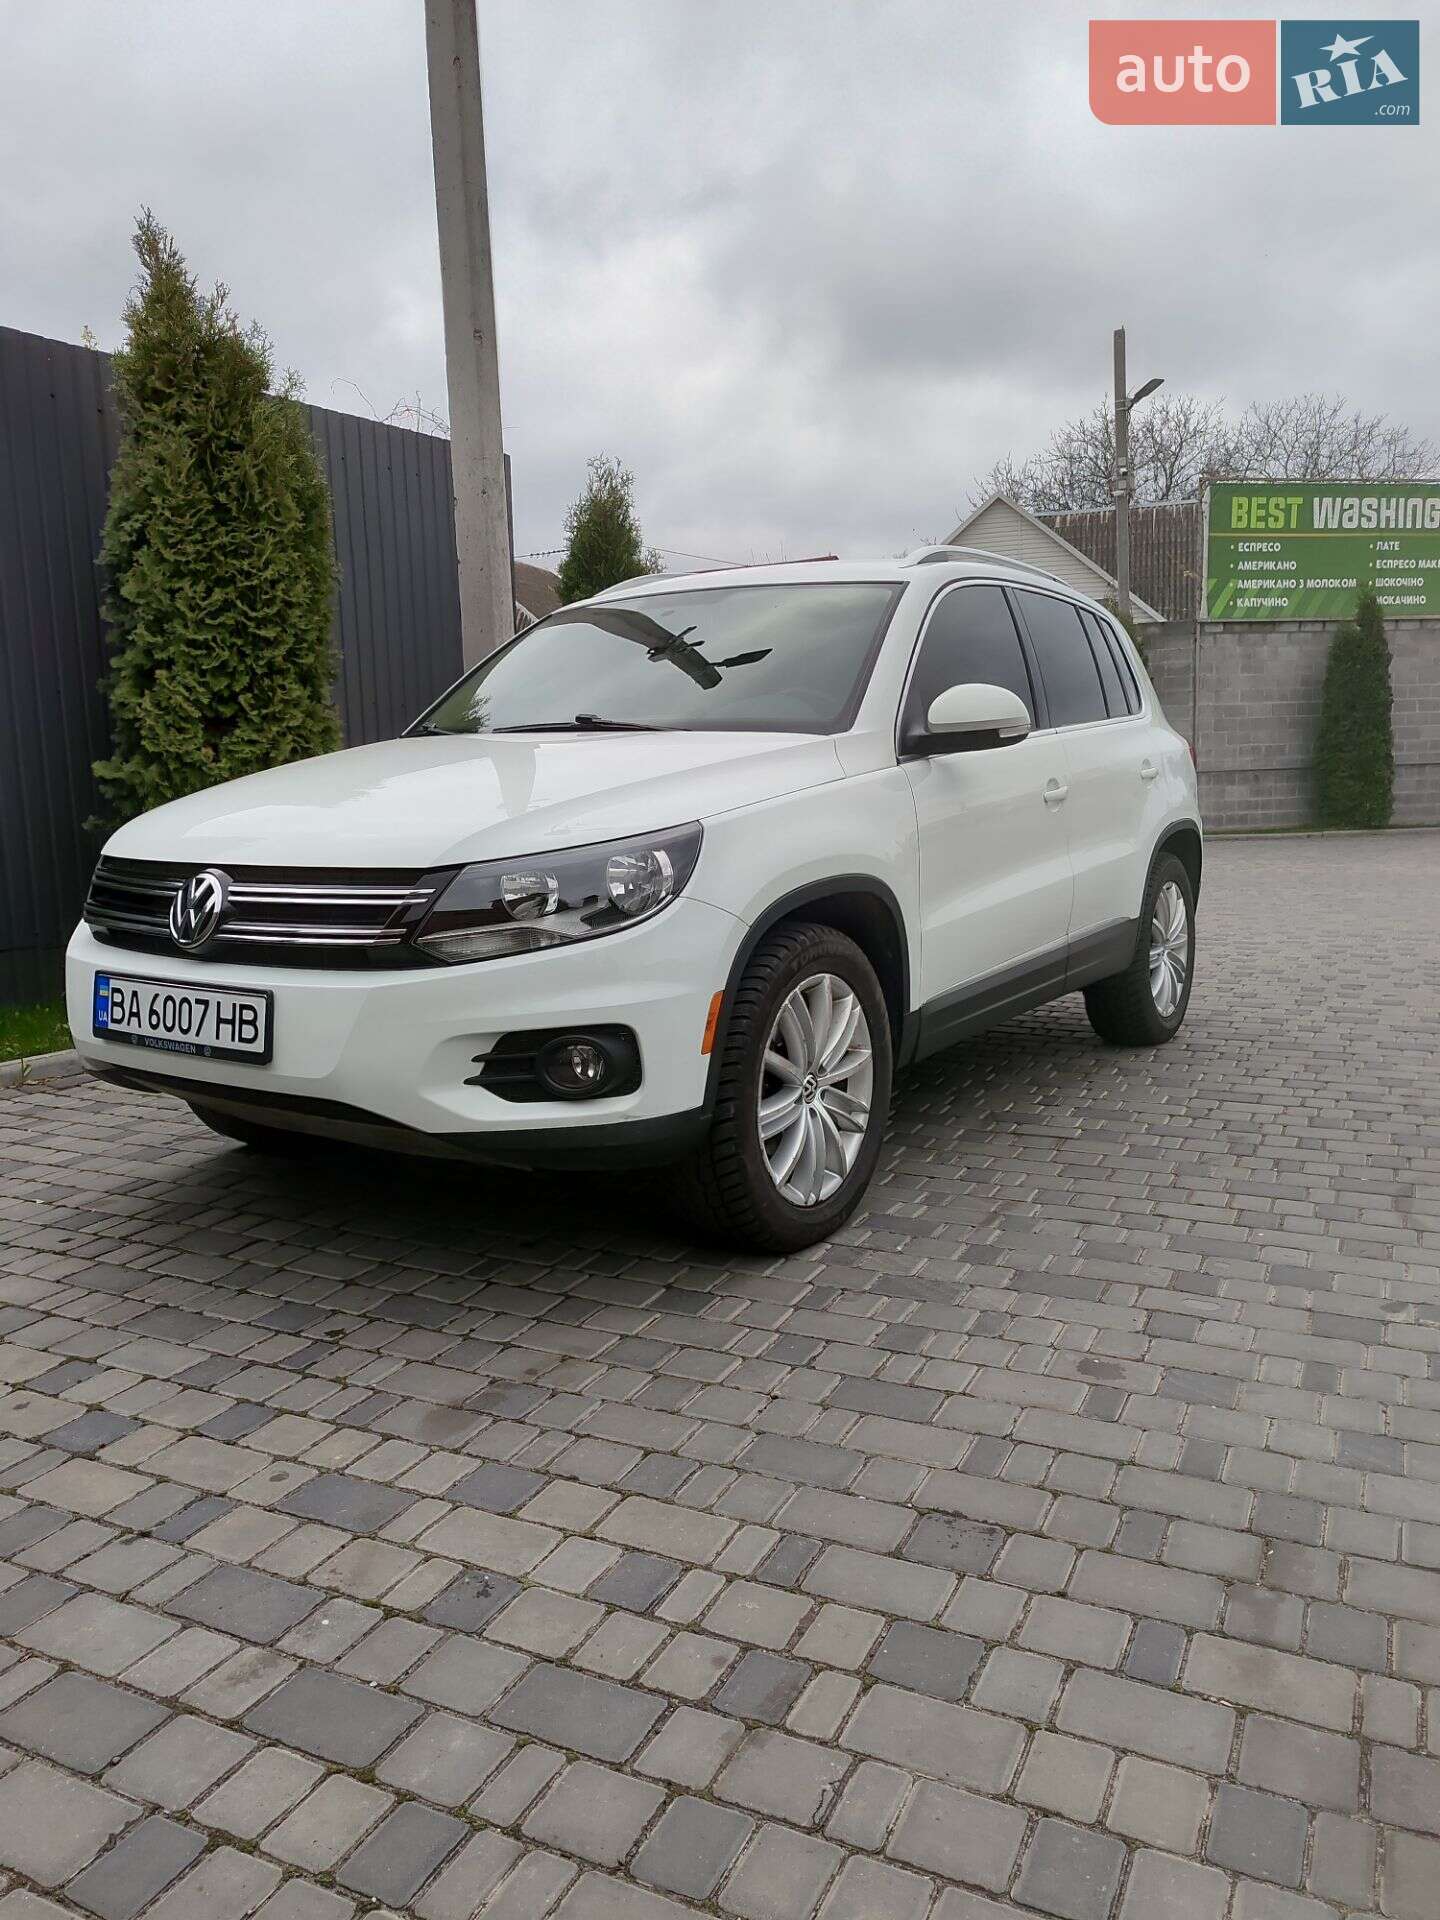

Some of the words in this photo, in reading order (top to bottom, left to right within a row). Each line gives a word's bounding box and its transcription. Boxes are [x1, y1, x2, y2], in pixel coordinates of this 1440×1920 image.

[1231, 496, 1304, 529] BEST
[1238, 542, 1281, 552] ЕСПРЕСО
[1375, 541, 1401, 551] ЛАТЕ
[1237, 561, 1297, 571] АМЕРИКАНО
[1376, 559, 1416, 569] ЕСПРЕСО
[1237, 579, 1297, 589] АМЕРИКАНО
[1306, 578, 1357, 588] МОЛОКОМ
[1236, 597, 1289, 608] КАПУЧИНО
[98, 1010, 108, 1022] UA
[110, 987, 142, 1029] BA
[148, 993, 210, 1037] 6007
[215, 1001, 259, 1044] HB
[144, 1037, 197, 1054] VOLKSWAGEN
